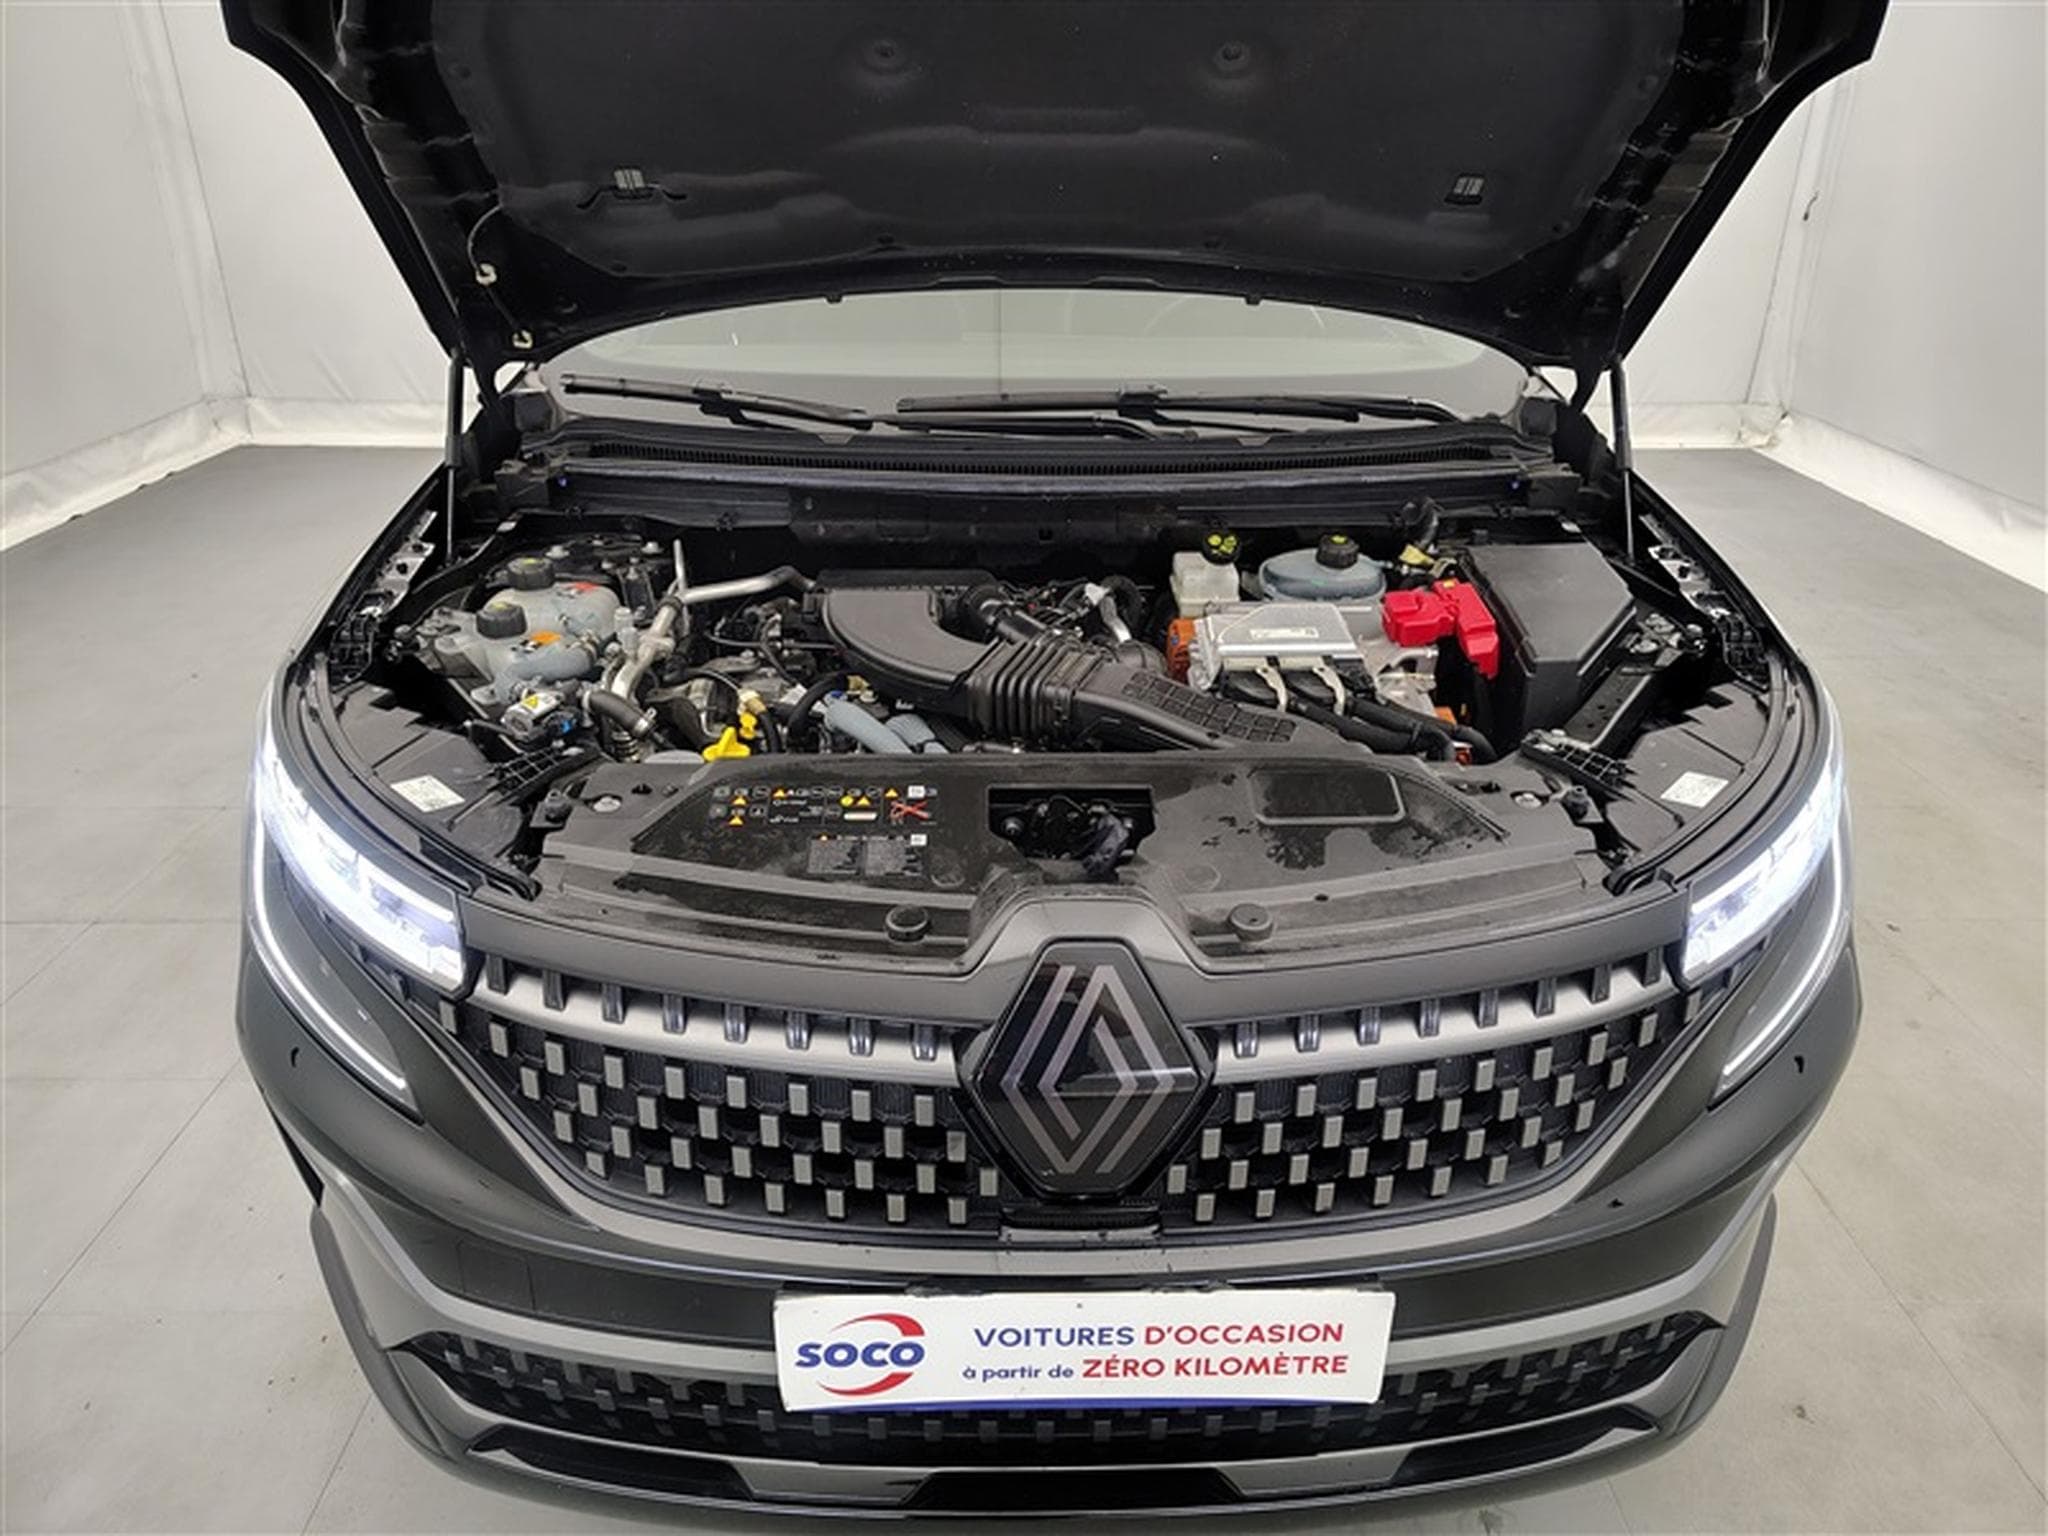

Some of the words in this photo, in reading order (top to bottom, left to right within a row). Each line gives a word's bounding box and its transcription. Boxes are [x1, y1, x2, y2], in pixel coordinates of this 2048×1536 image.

[973, 1326, 1136, 1348] VOITURES
[1143, 1323, 1344, 1346] D'OCCASION
[795, 1342, 925, 1369] SOCO
[961, 1362, 977, 1380] à
[982, 1362, 1042, 1384] partir
[1047, 1361, 1075, 1380] de
[1082, 1352, 1167, 1379] ZÉRO
[1174, 1351, 1349, 1377] KILOMÈTRE
